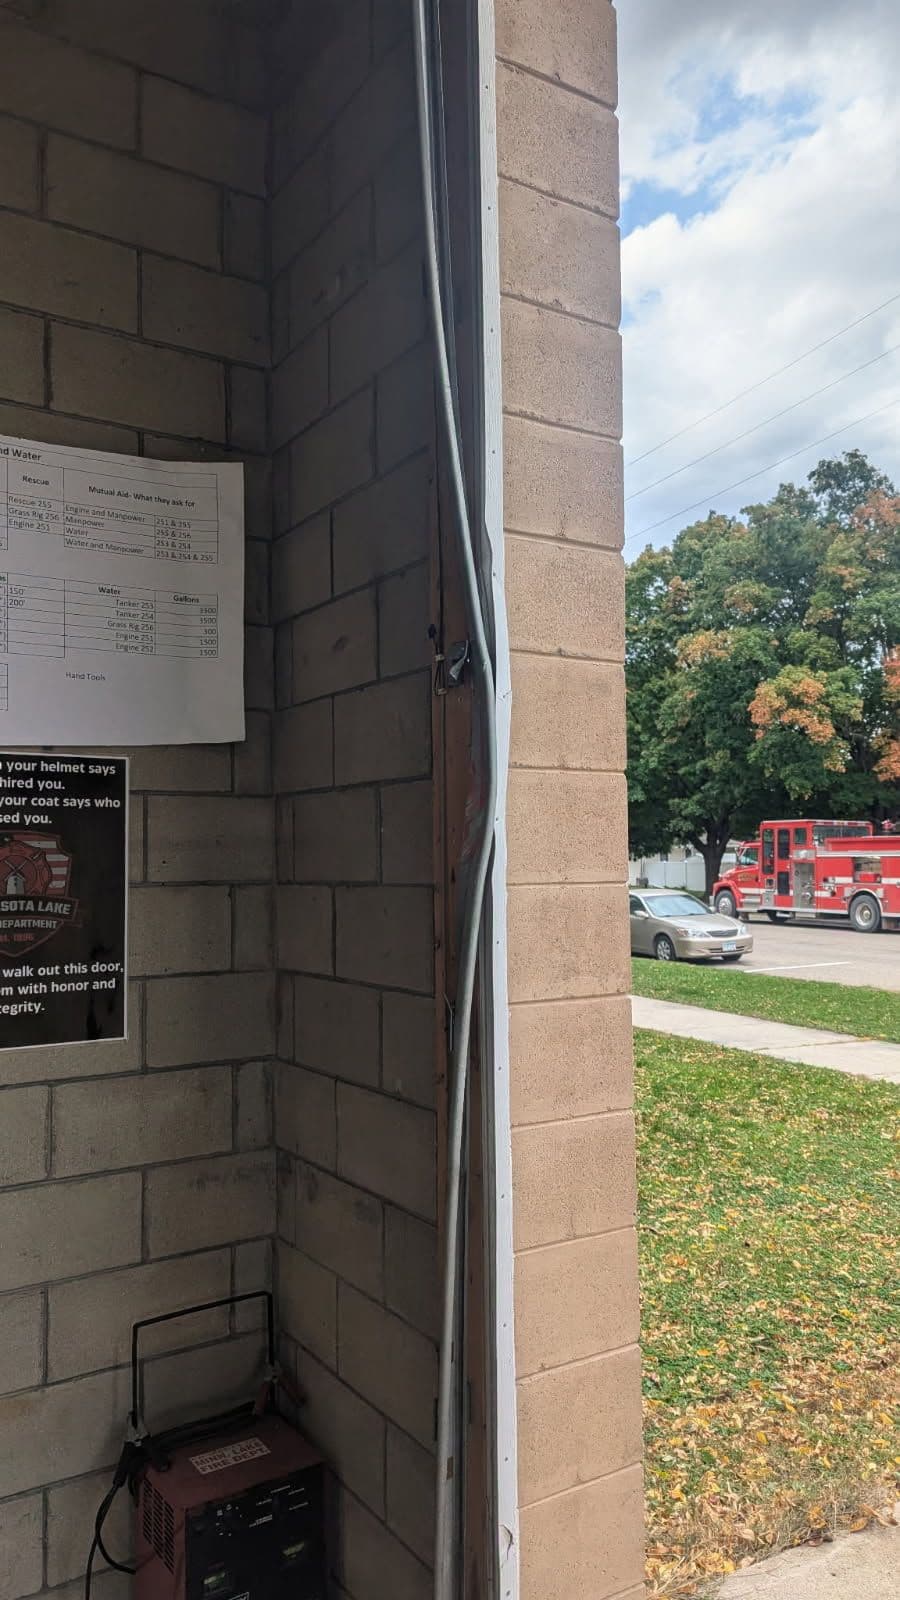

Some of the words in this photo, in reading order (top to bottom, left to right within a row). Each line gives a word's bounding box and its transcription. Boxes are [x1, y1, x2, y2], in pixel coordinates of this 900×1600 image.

[12, 448, 42, 461] Water
[22, 475, 49, 486] Rescue
[9, 496, 36, 506] Rescue
[88, 486, 115, 497] Mutual
[133, 493, 153, 502] What
[154, 495, 170, 507] they
[171, 498, 183, 506] ask
[185, 500, 195, 508] for
[9, 507, 30, 518] Grass
[32, 511, 43, 521] Rig
[44, 513, 60, 521] 256
[65, 505, 90, 516] Engine
[91, 508, 106, 517] and
[107, 511, 146, 523] Manpower
[9, 518, 35, 529] Engine
[65, 516, 105, 528] Manpower
[65, 526, 88, 537] Water
[65, 537, 89, 548] Water
[90, 541, 104, 549] and
[105, 543, 144, 555] Manpower
[98, 586, 121, 596] Water
[116, 599, 139, 608] Tanker
[173, 594, 200, 604] Gallons
[116, 610, 139, 618] Tanker
[107, 620, 127, 629] Grass
[128, 622, 140, 632] Rig
[115, 632, 139, 642] Engine
[115, 643, 139, 652] Engine
[65, 672, 85, 680] Hand
[87, 673, 106, 681] Tools
[6, 761, 37, 773] your
[40, 760, 85, 773] helmet
[88, 764, 116, 777] says
[0, 776, 33, 789] hired
[37, 780, 65, 792] you.
[31, 796, 60, 807] coat
[62, 797, 91, 809] says
[94, 796, 121, 808] who
[23, 814, 53, 826] you.
[38, 901, 72, 915] LAKE
[2, 965, 34, 978] walk
[37, 965, 61, 976] out
[64, 962, 88, 975] this
[0, 985, 13, 996] m
[17, 982, 47, 995] with
[51, 981, 89, 993] honor
[92, 978, 116, 990] and
